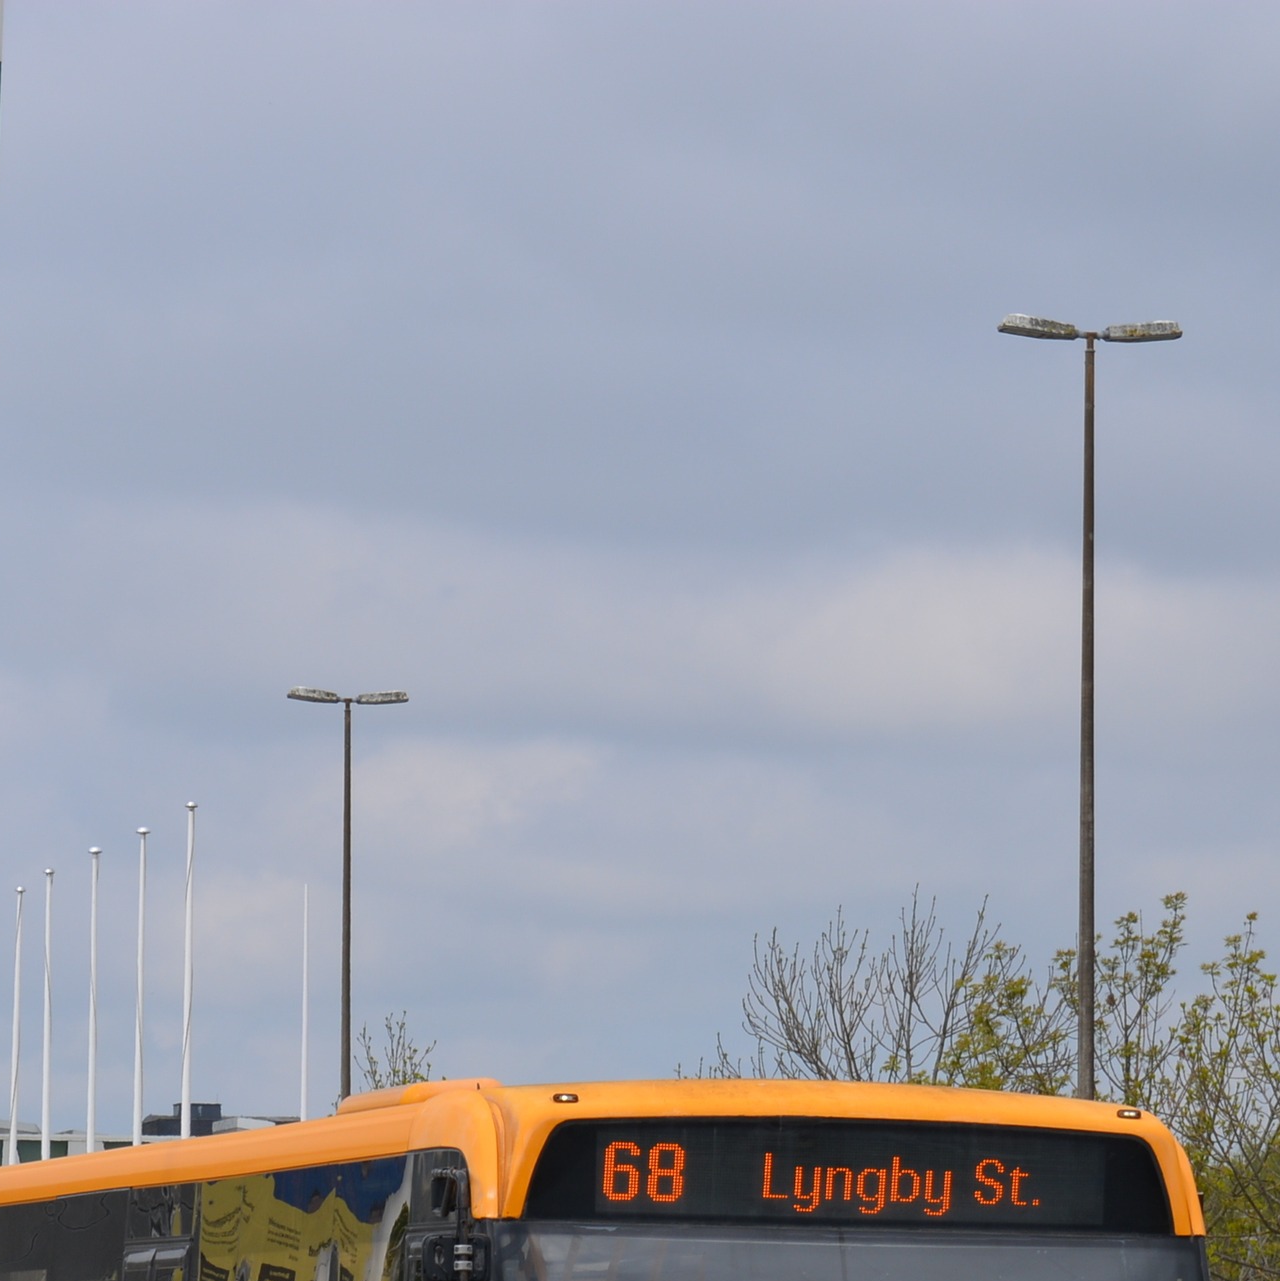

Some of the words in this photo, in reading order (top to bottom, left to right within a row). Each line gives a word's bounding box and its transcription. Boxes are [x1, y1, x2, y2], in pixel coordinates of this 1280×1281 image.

[603, 1141, 685, 1202] 68
[762, 1152, 952, 1216] Lyngby
[974, 1158, 1040, 1206] St.
